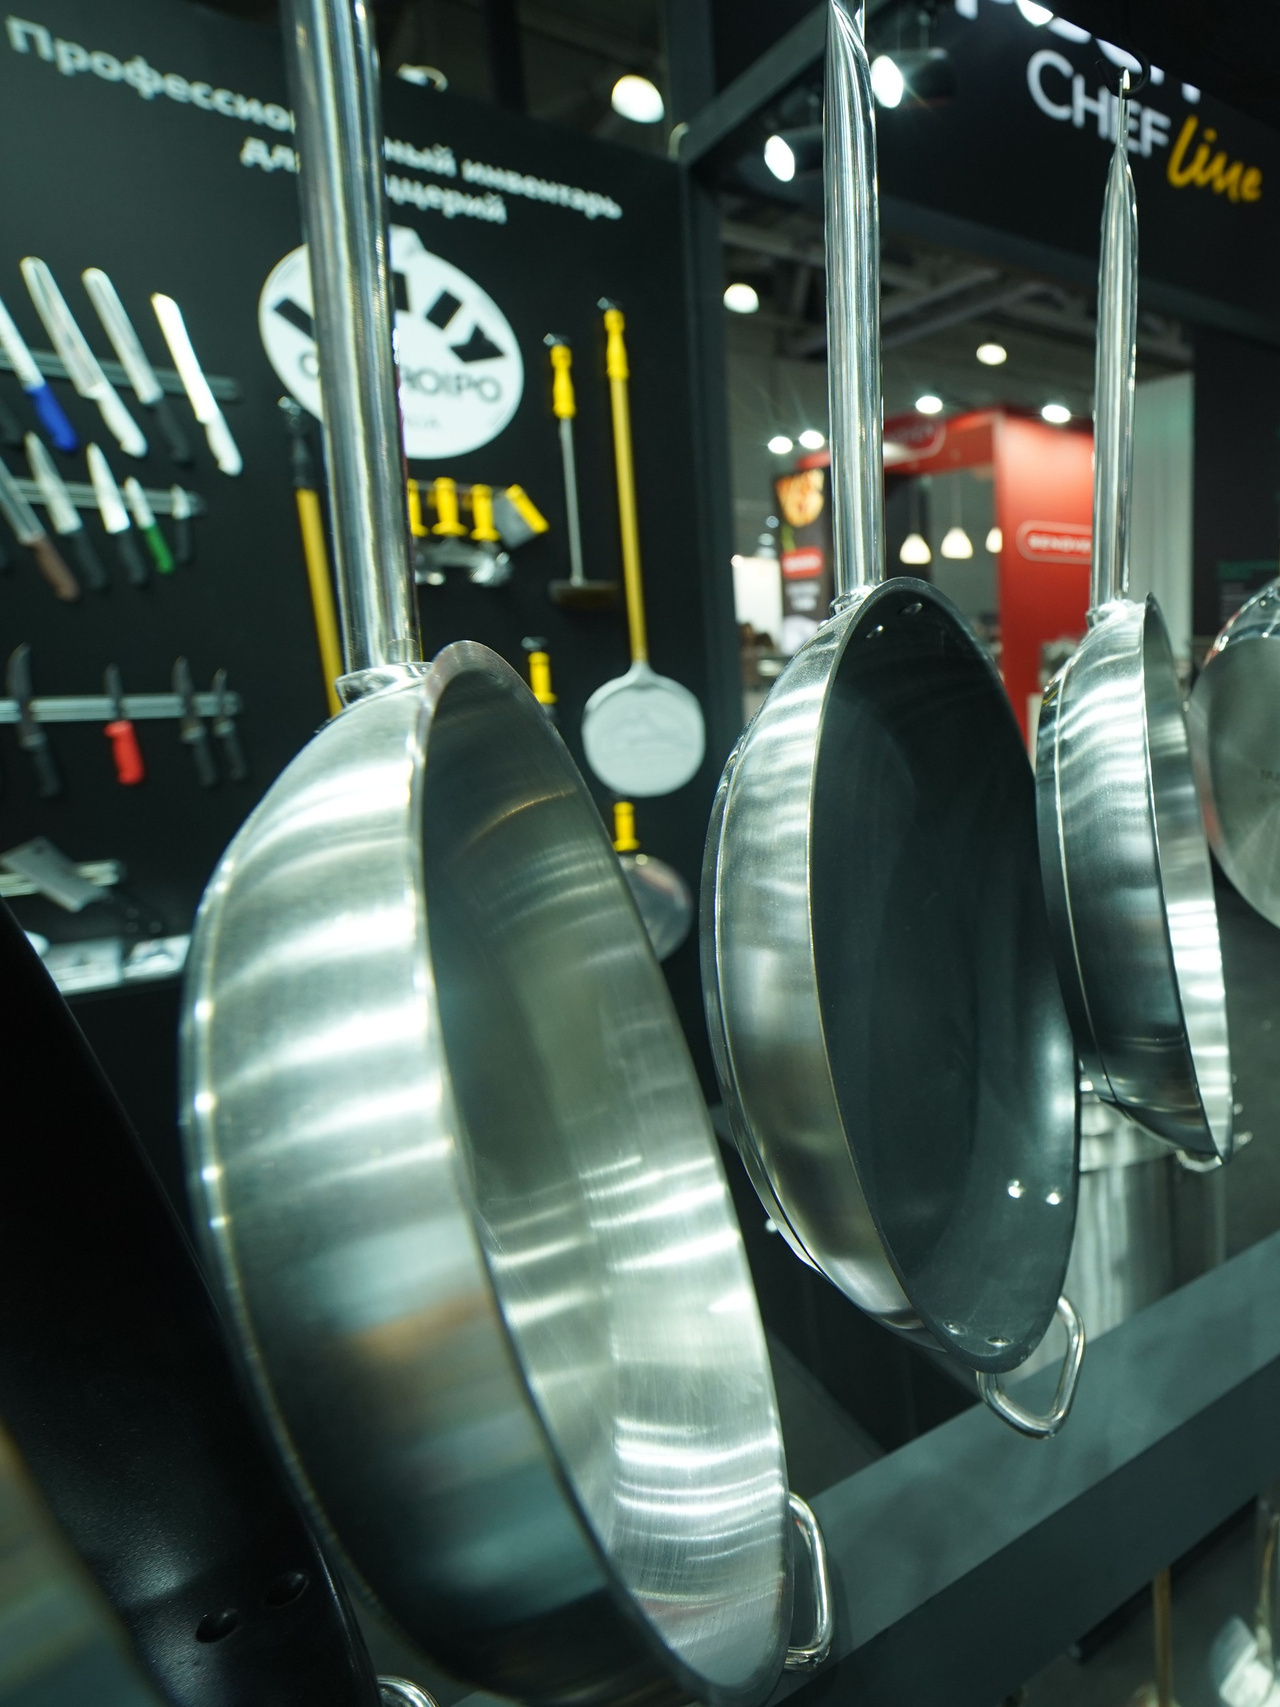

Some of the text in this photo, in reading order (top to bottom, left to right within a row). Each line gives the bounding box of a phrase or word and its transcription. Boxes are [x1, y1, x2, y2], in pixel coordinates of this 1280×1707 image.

[240, 135, 299, 174] дл
[1027, 49, 1263, 204] CHEF line
[461, 158, 623, 220] инвентарь
